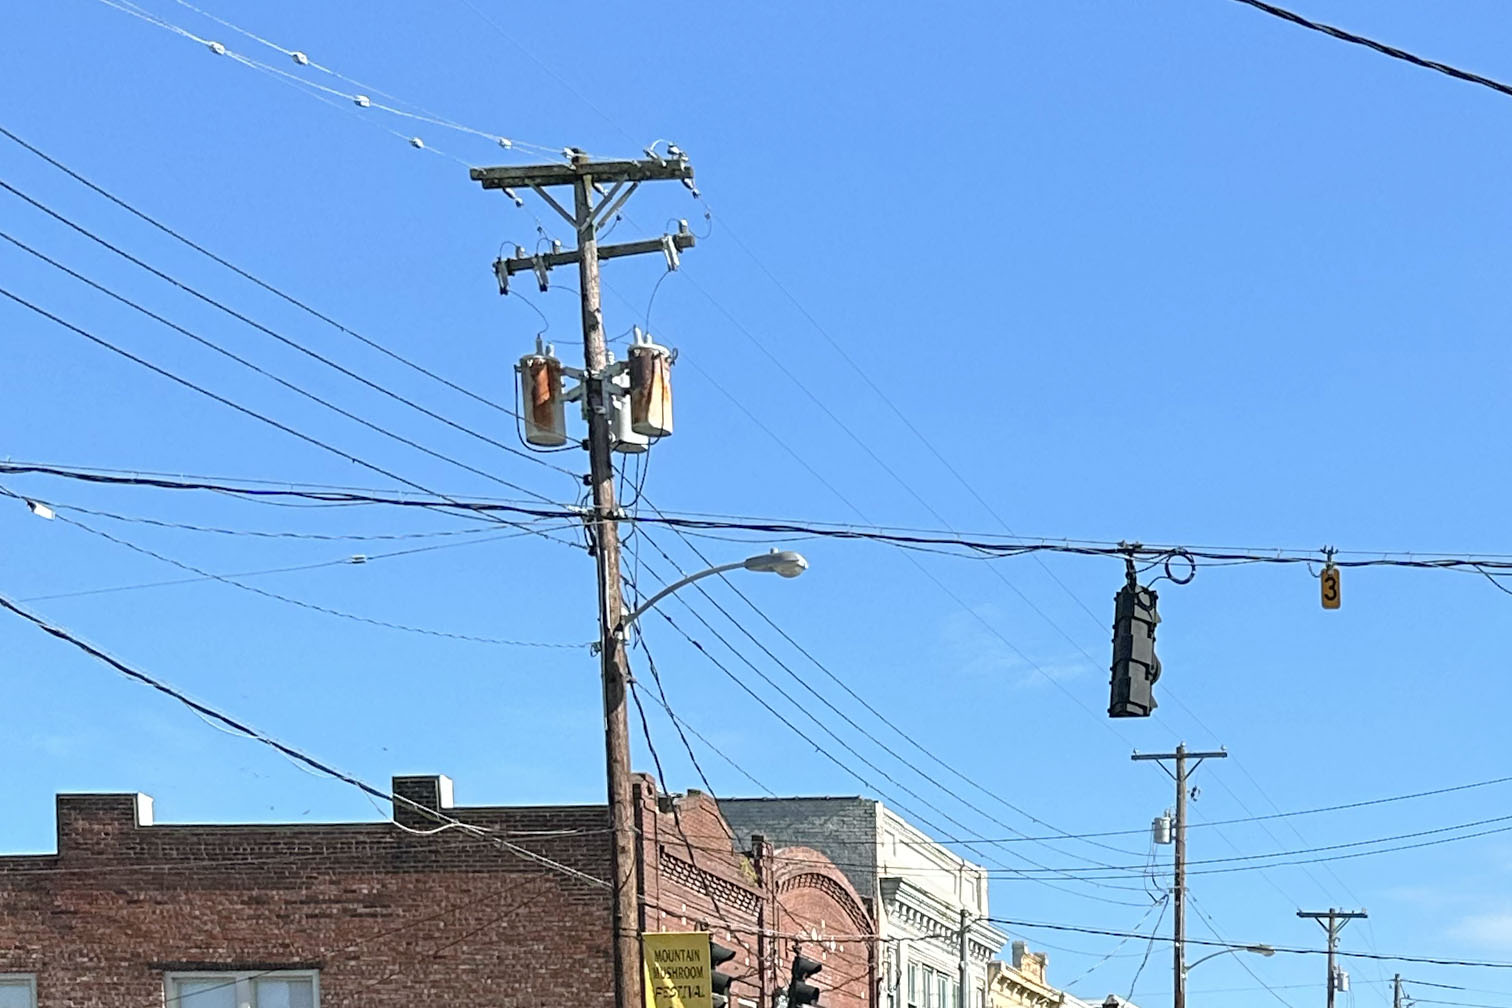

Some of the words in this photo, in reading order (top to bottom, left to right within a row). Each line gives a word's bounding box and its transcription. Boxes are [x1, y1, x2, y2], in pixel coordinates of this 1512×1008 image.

[1324, 577, 1337, 601] 3
[654, 949, 701, 962] MOUNTAIN
[653, 966, 704, 979] MUSHROOM
[655, 985, 706, 999] FESTIVAL
